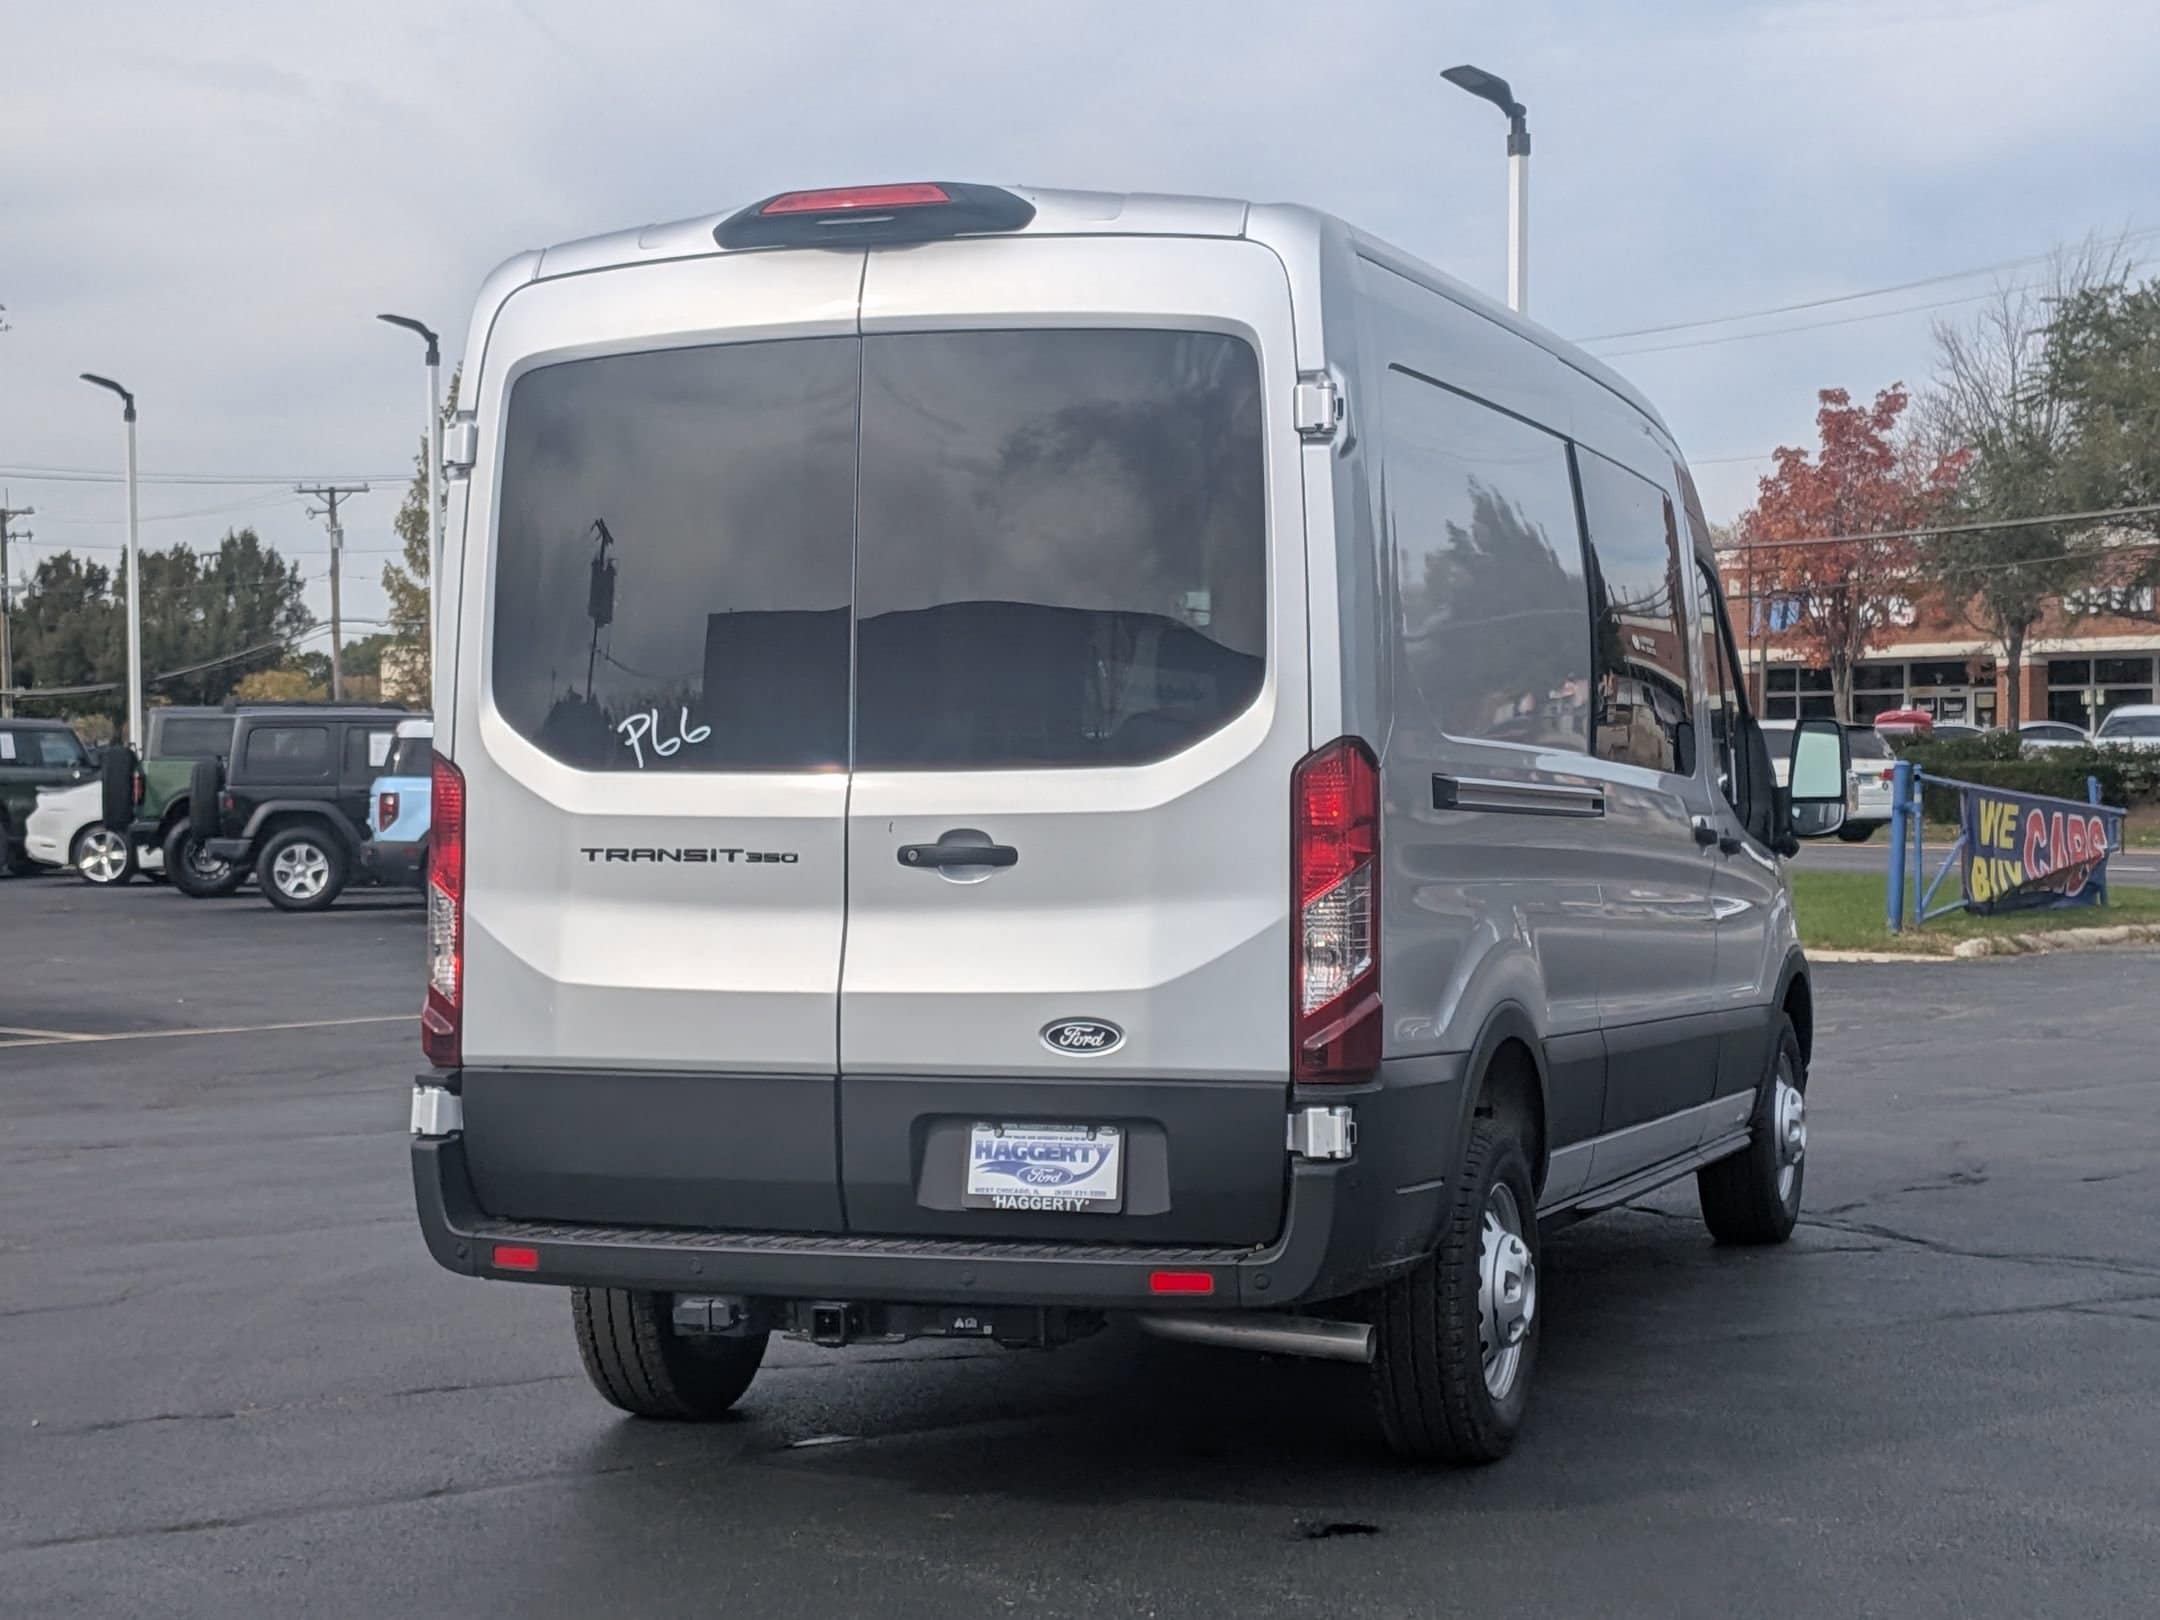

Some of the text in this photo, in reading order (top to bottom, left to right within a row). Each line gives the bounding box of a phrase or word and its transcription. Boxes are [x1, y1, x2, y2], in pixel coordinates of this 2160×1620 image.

[617, 706, 712, 769] P66
[1979, 798, 2019, 849] WE
[1059, 1026, 1106, 1047] Ford
[974, 1140, 1114, 1164] HAGGERTY
[1026, 1168, 1062, 1185] Ford
[995, 1195, 1085, 1212] HAGGERTY
